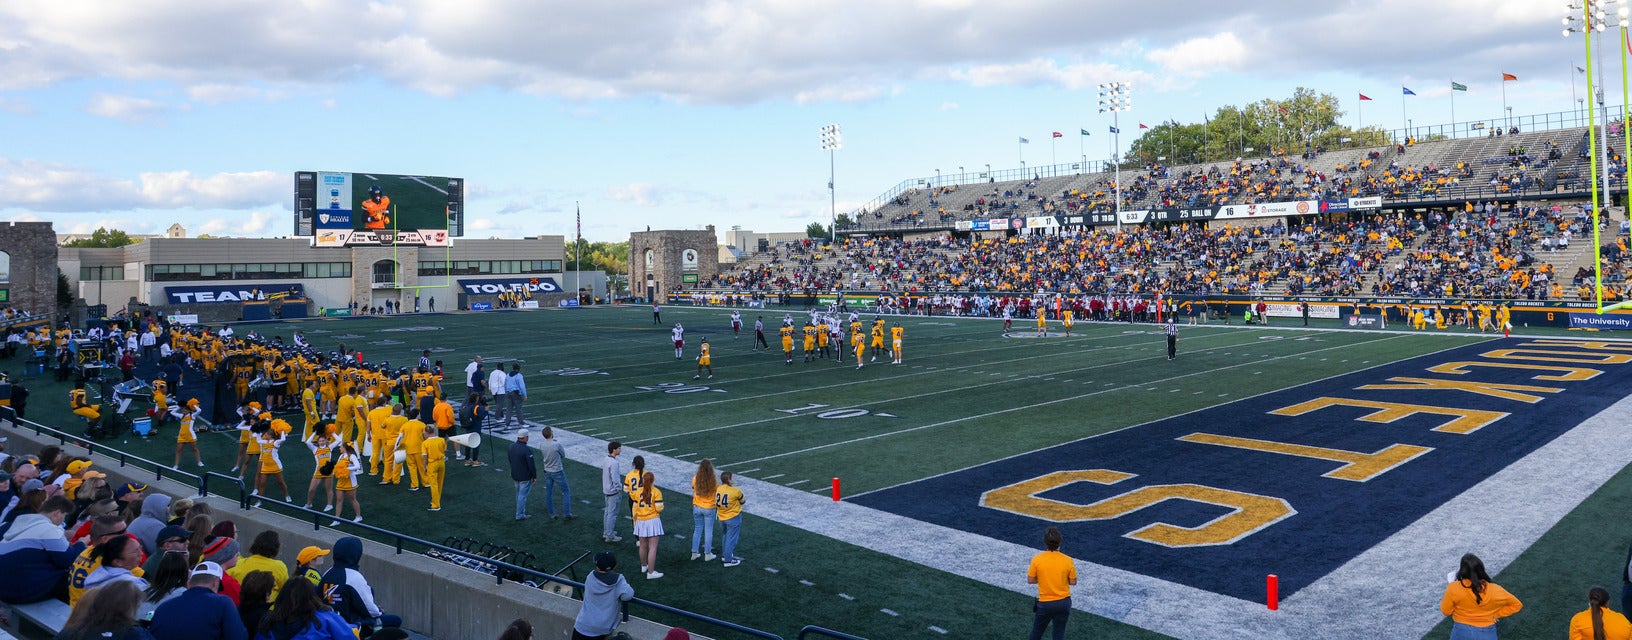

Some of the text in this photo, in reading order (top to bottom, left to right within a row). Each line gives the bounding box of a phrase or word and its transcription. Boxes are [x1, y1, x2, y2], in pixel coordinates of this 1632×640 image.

[1092, 214, 1099, 222] 10
[1180, 209, 1188, 218] 25
[1191, 209, 1203, 217] BALL
[1046, 217, 1051, 225] 17
[466, 282, 555, 294] TOLEDO
[172, 289, 265, 303] TEAM
[1589, 318, 1630, 327] University
[366, 377, 377, 387] 34
[415, 379, 427, 388] 83
[774, 403, 870, 419] 10
[716, 493, 728, 508] 24
